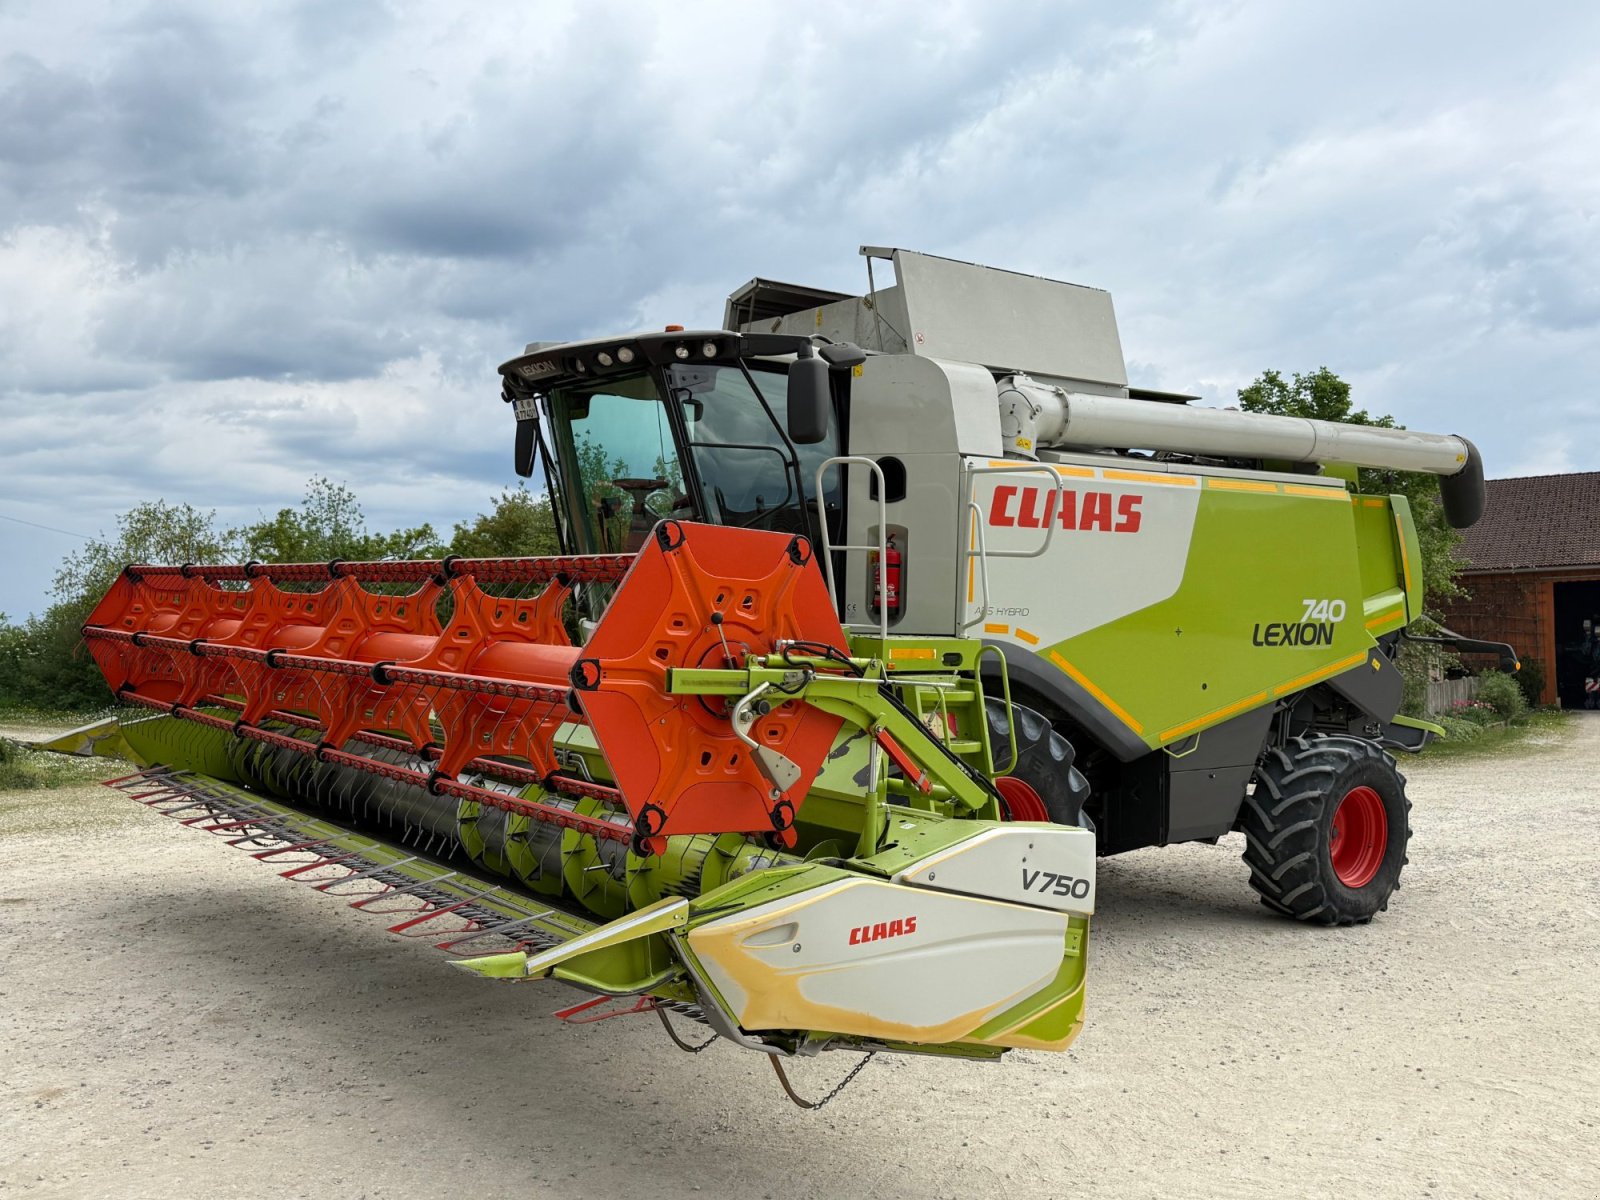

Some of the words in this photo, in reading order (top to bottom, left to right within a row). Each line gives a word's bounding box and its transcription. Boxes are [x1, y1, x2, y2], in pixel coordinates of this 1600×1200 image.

[518, 360, 556, 376] LEXION
[989, 485, 1143, 533] CLAAS
[1300, 599, 1346, 622] 740
[1252, 622, 1334, 647] LEXION
[849, 916, 917, 946] CLAAS
